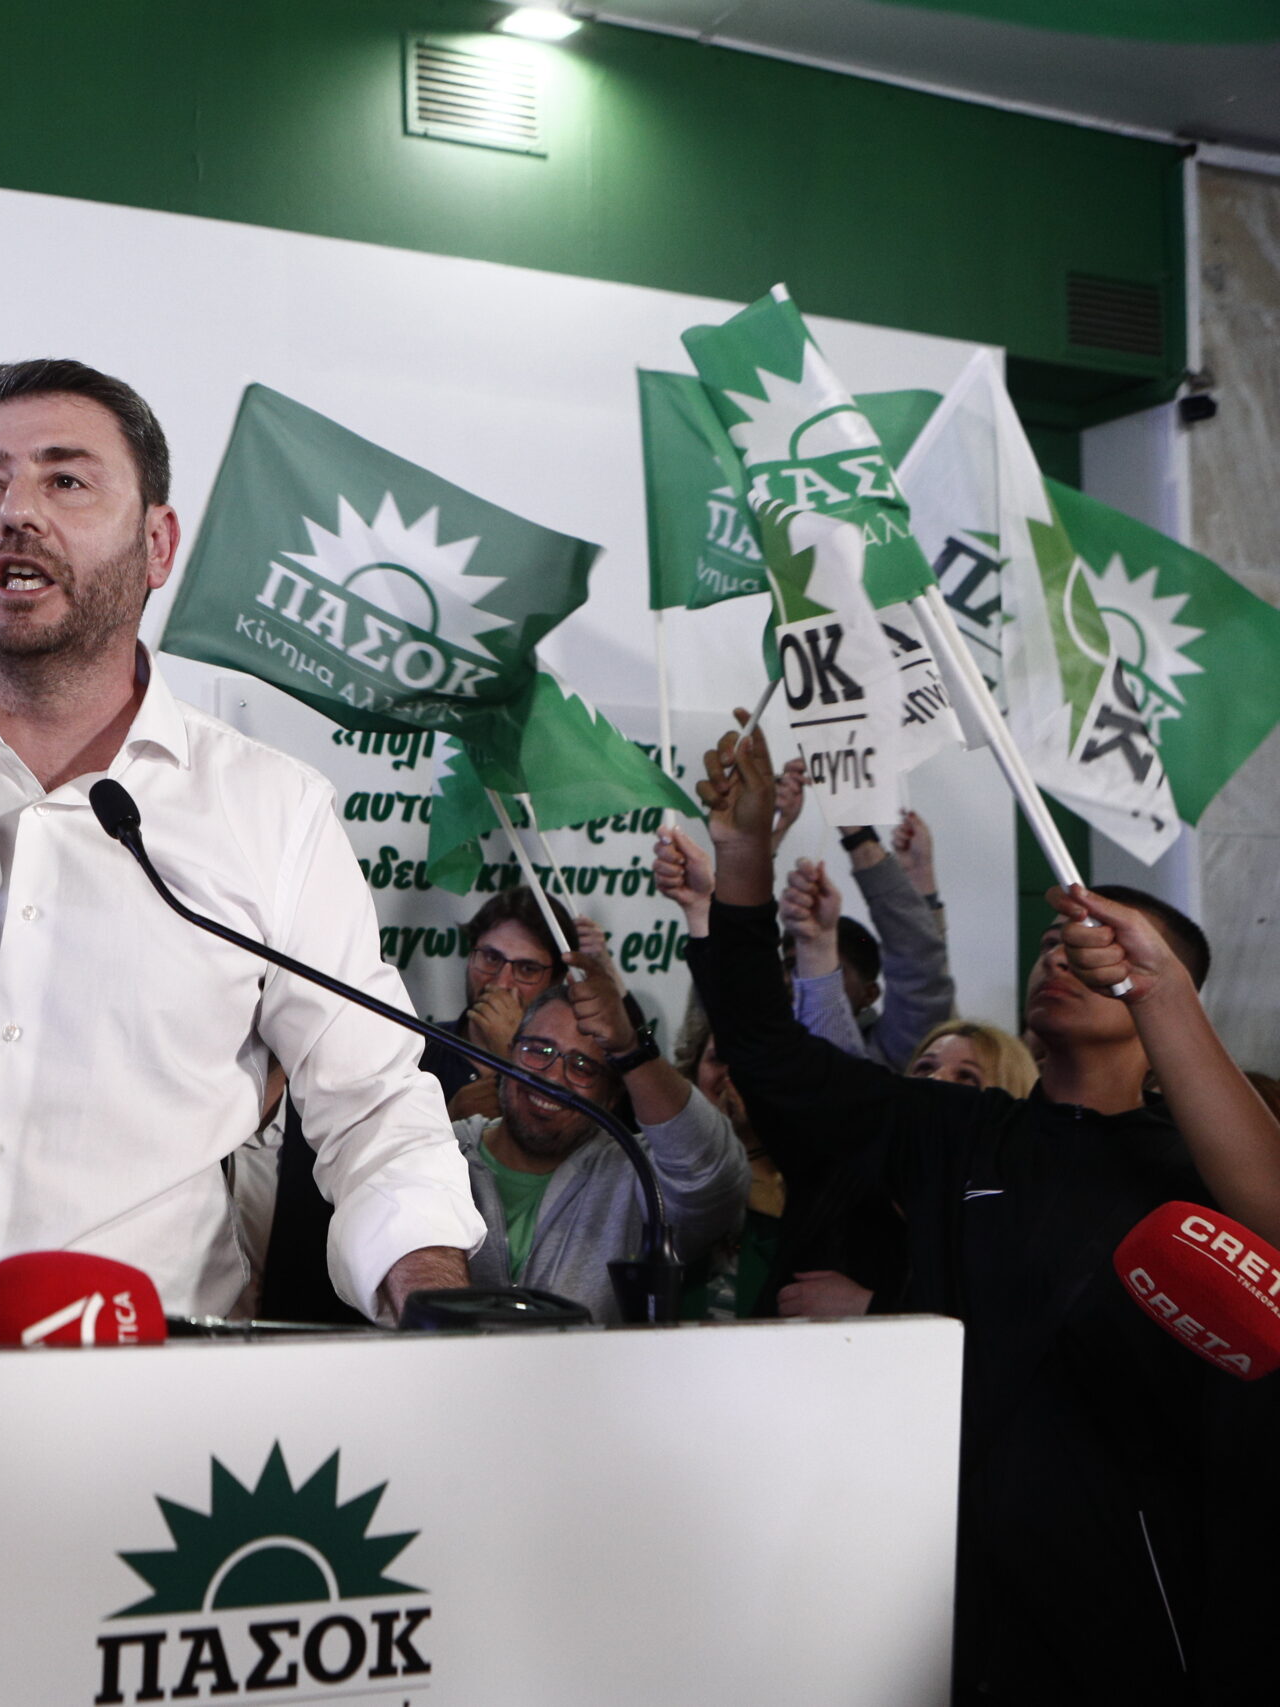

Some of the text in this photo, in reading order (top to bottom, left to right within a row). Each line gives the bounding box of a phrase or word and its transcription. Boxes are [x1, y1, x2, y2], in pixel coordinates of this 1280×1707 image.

[235, 613, 335, 689] Κίνημα
[255, 560, 499, 698] ΠΑΣΟΚ
[1128, 1267, 1252, 1374] CRETA
[93, 1606, 432, 1706] ΠΑΣΟΚ
